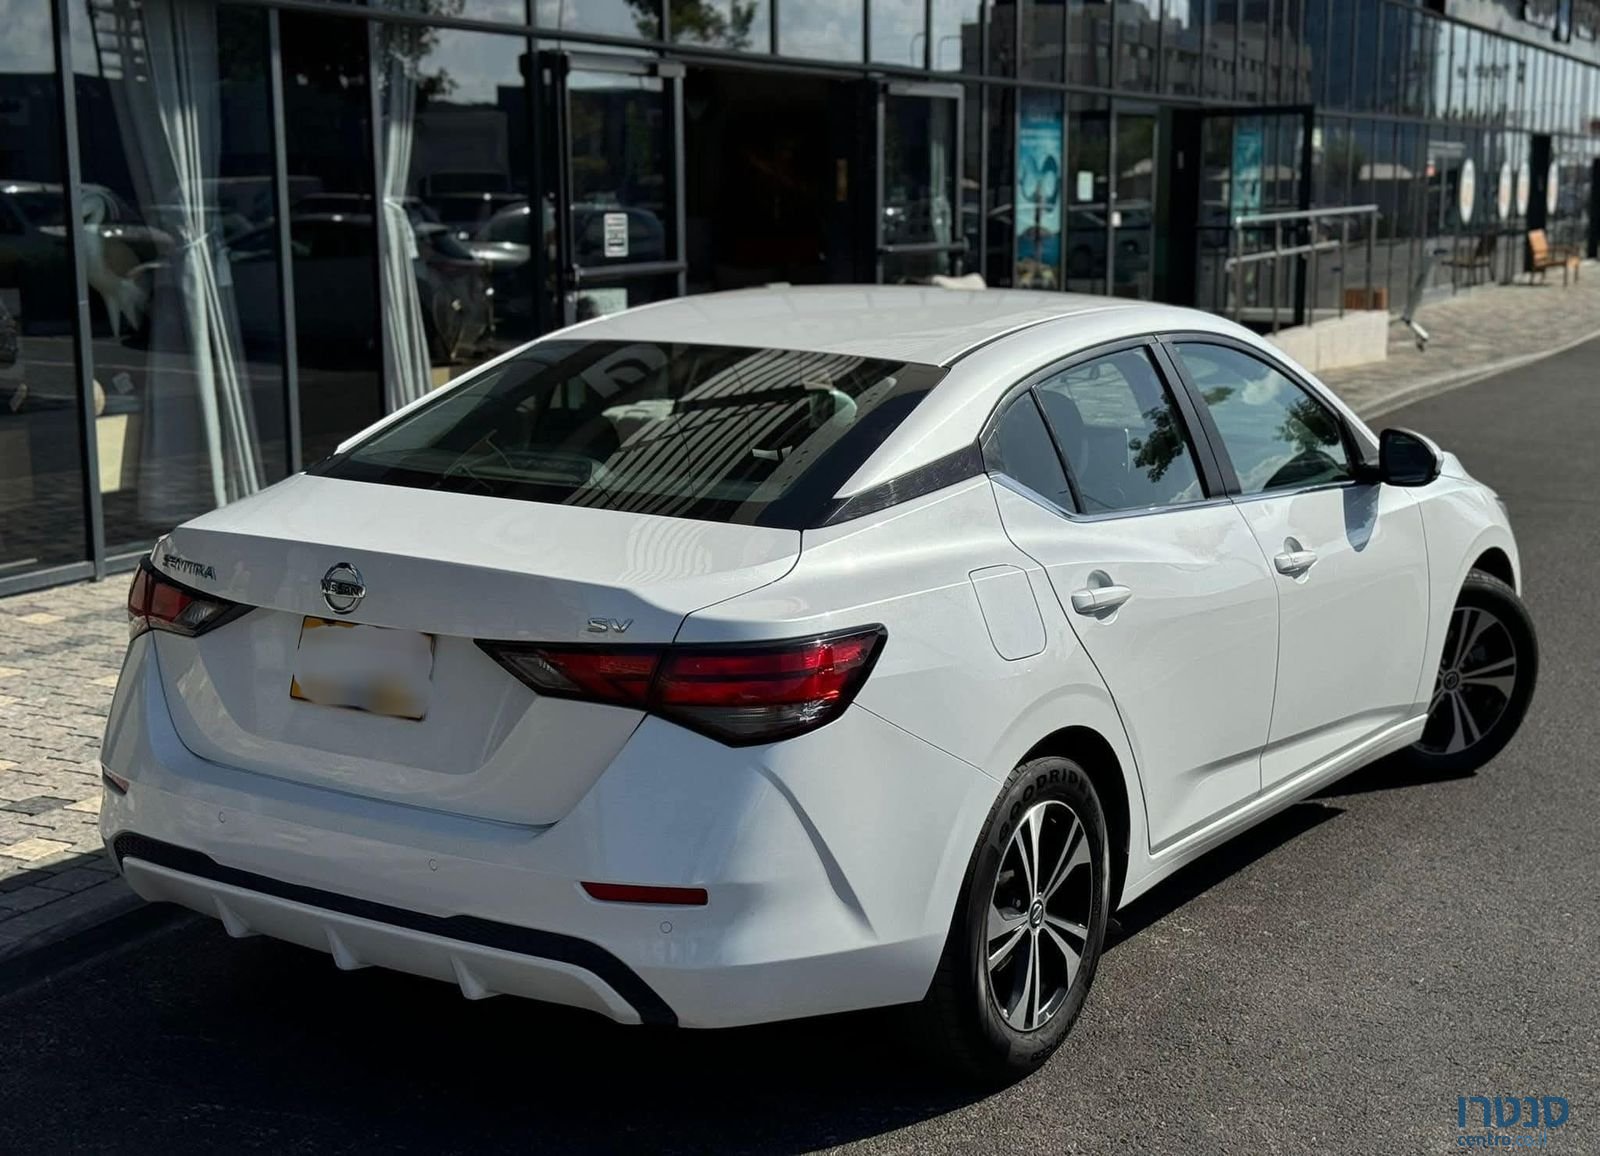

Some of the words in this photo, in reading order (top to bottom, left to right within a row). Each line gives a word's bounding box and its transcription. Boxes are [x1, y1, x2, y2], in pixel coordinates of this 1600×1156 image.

[162, 554, 217, 581] SENTRA
[321, 579, 360, 597] NISSAN
[588, 617, 634, 633] SV
